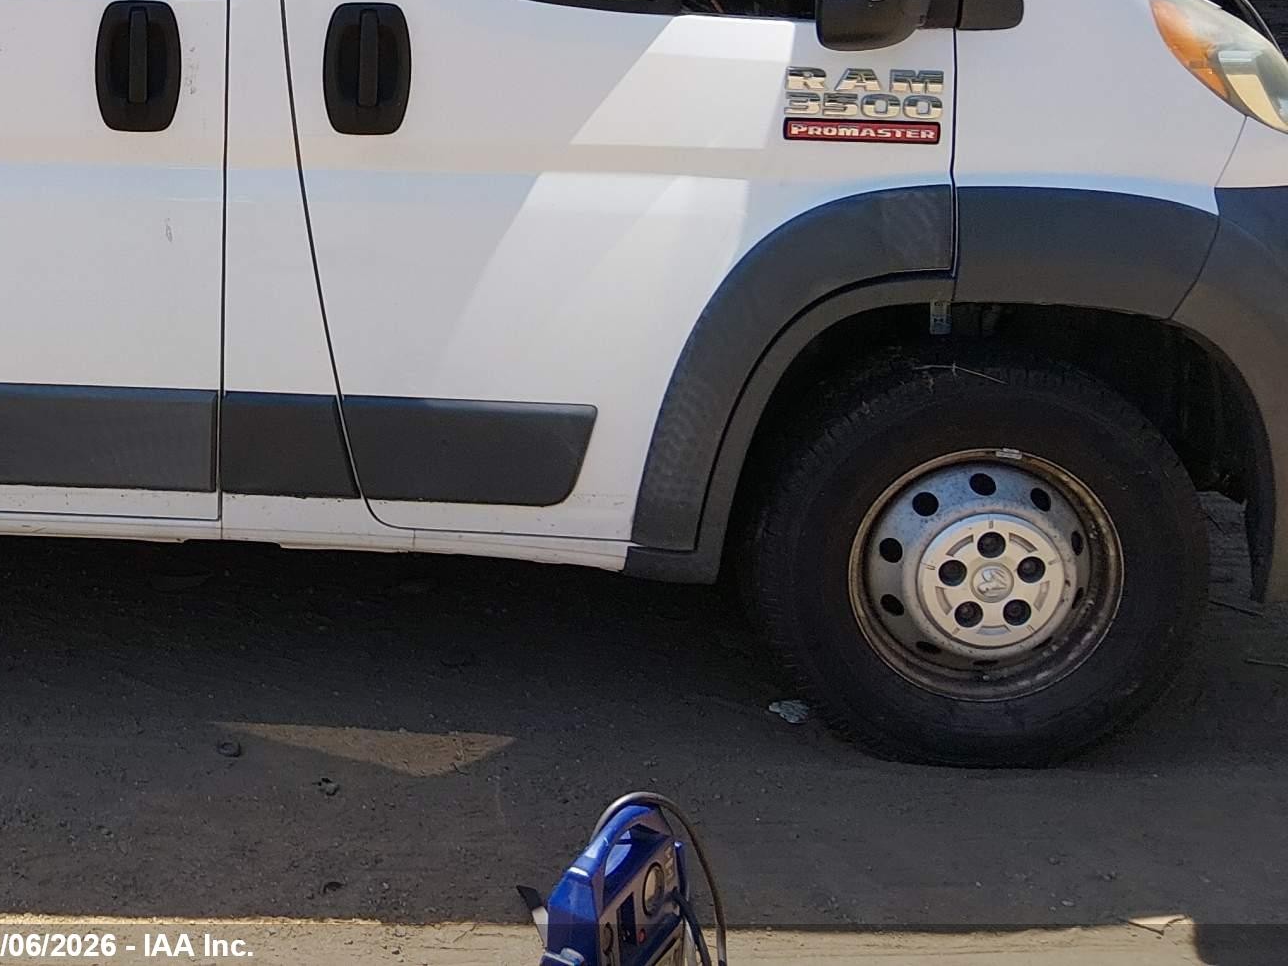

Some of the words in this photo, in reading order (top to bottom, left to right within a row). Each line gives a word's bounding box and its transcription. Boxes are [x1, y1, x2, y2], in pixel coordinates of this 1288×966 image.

[786, 66, 944, 93] RAM
[784, 92, 943, 119] 3500
[790, 123, 935, 139] PROMASTER
